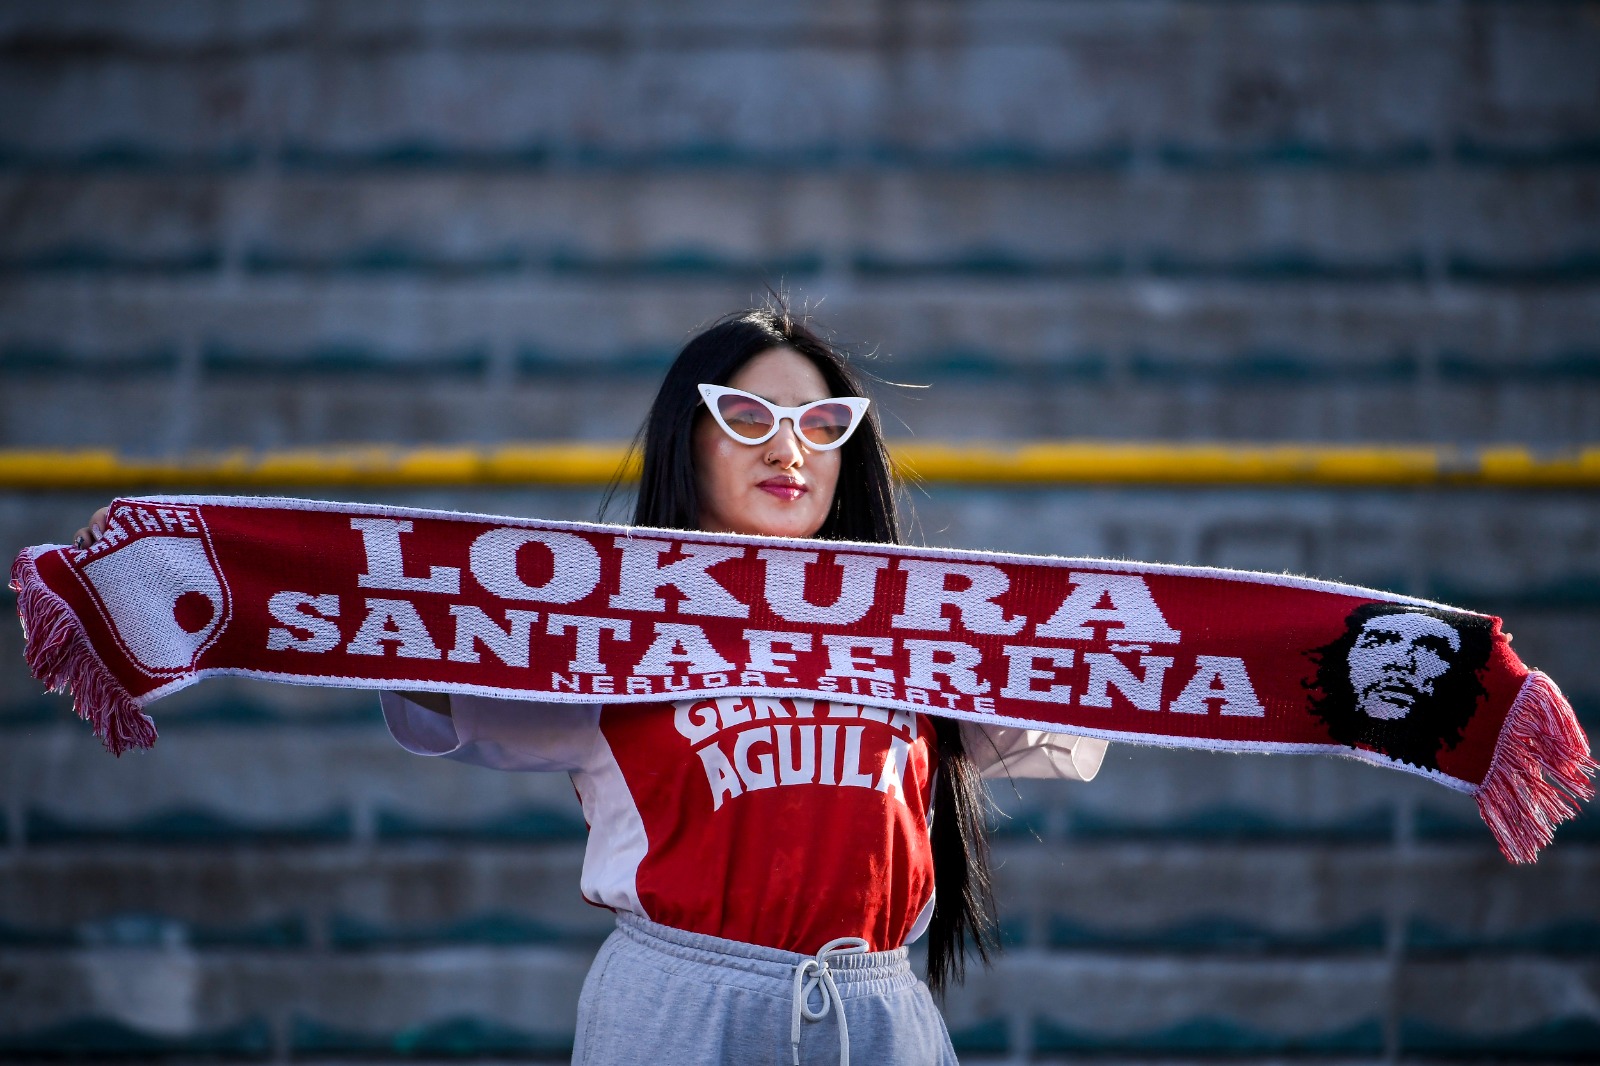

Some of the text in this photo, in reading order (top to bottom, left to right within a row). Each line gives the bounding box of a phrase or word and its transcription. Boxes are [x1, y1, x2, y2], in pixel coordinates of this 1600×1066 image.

[156, 508, 199, 533] FE
[349, 517, 1181, 645] LOKURA
[266, 590, 1266, 718] SANTAFEREÑA
[817, 676, 996, 715] SIBATE
[696, 724, 912, 812] AGUILA
